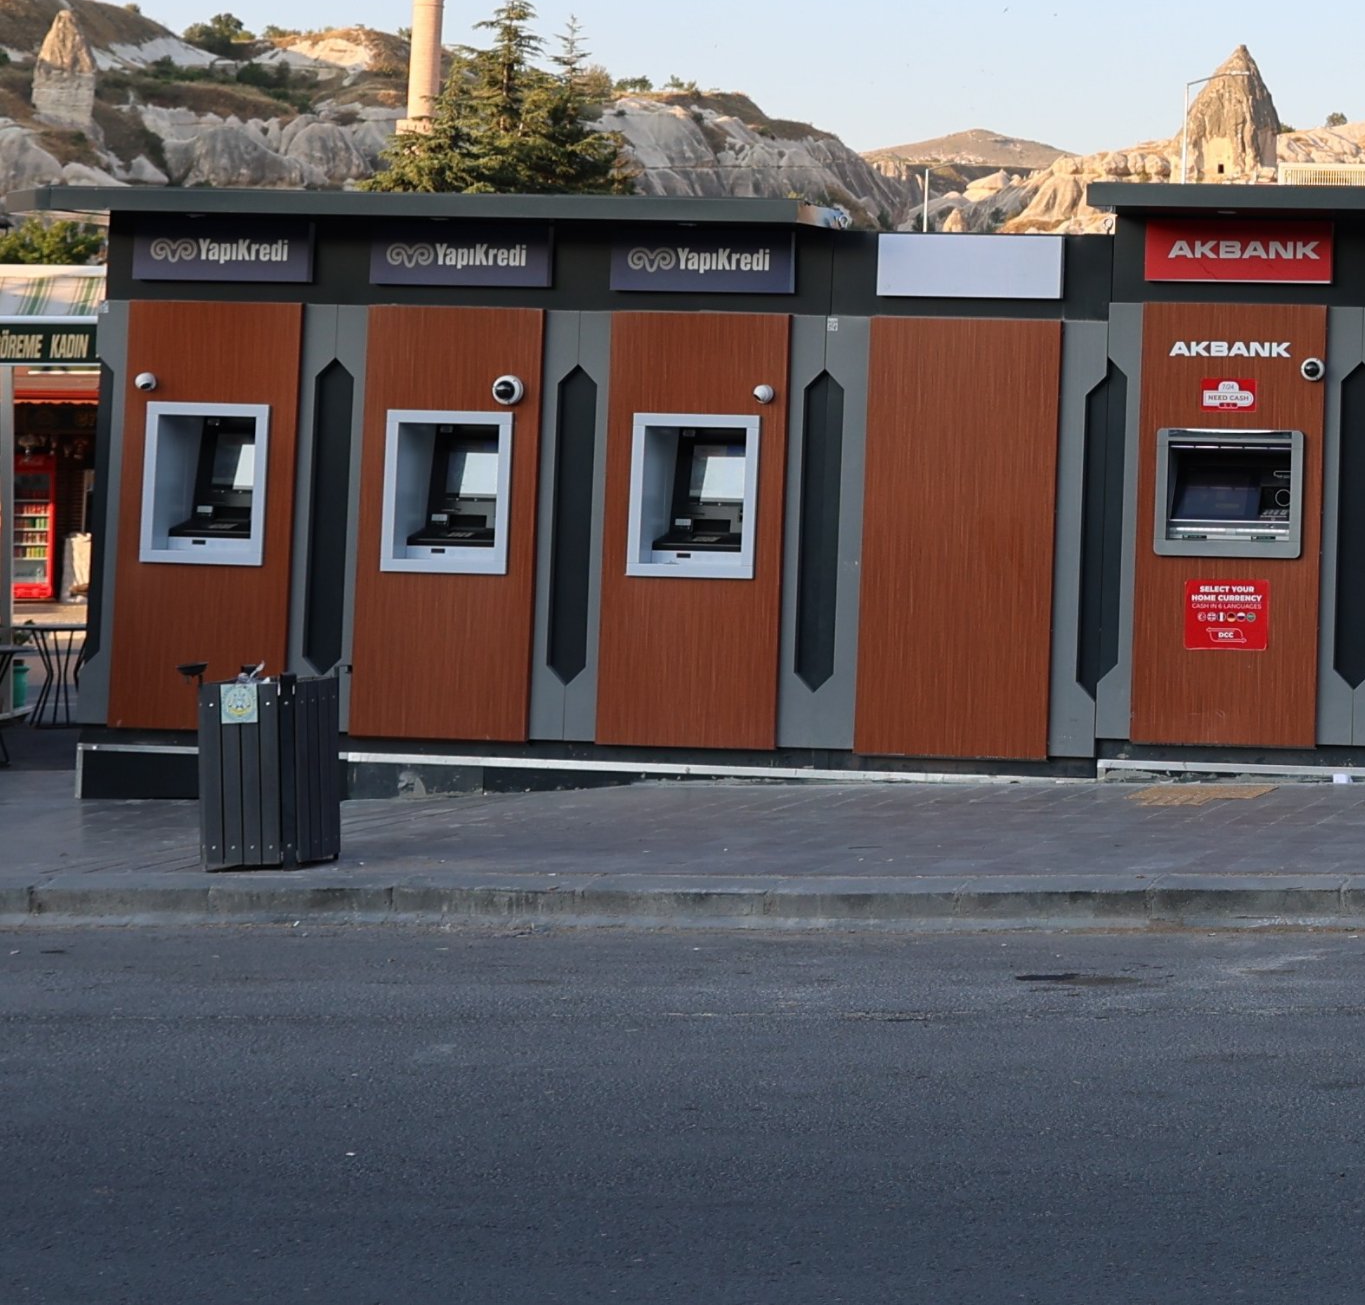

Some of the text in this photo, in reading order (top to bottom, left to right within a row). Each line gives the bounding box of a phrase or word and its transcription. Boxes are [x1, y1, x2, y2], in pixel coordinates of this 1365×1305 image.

[199, 239, 289, 264] YapıKredi
[435, 243, 527, 268] YapıKredi
[677, 247, 770, 274] YapıKredi
[1168, 240, 1320, 259] AKBANK
[0, 329, 89, 358] ÖREME KADIN
[1169, 341, 1292, 358] AKBANK
[1191, 594, 1262, 602] HOME CURRENCY
[1200, 585, 1255, 593] SELECT YOUR
